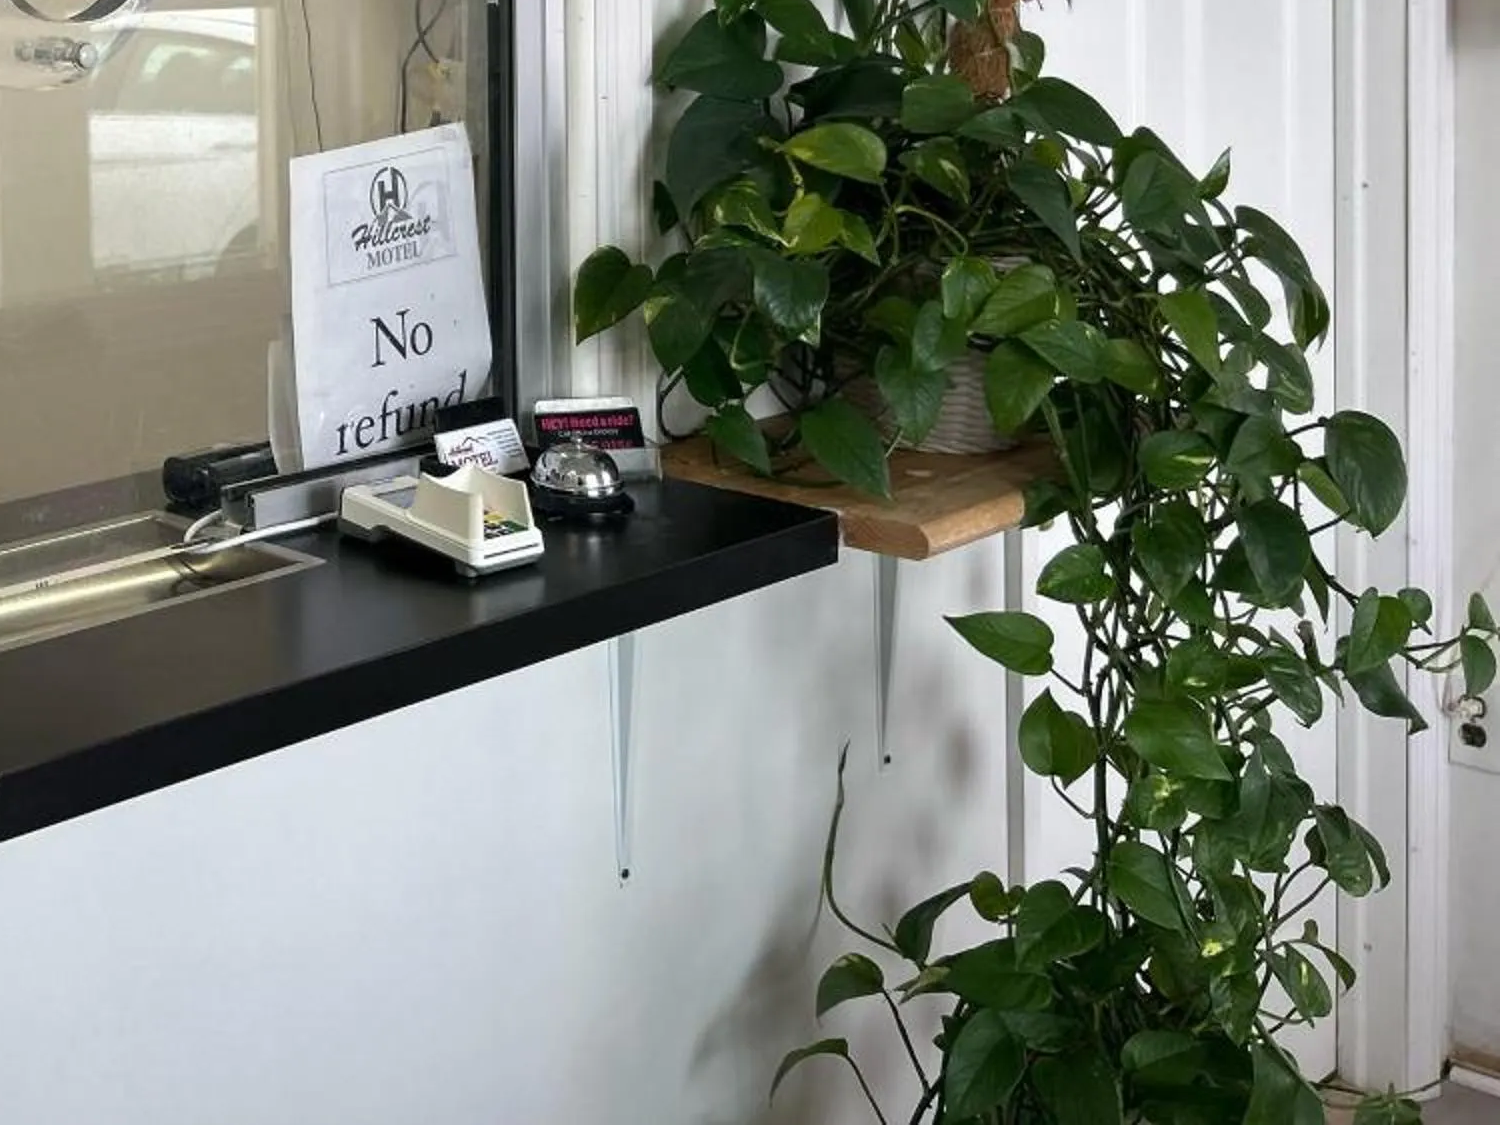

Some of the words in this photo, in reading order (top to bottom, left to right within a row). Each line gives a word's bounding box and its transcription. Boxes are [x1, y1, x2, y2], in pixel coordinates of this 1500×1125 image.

[351, 215, 431, 251] Hillcrest
[366, 240, 422, 270] MOTEL
[371, 308, 434, 368] No
[336, 368, 468, 456] refund
